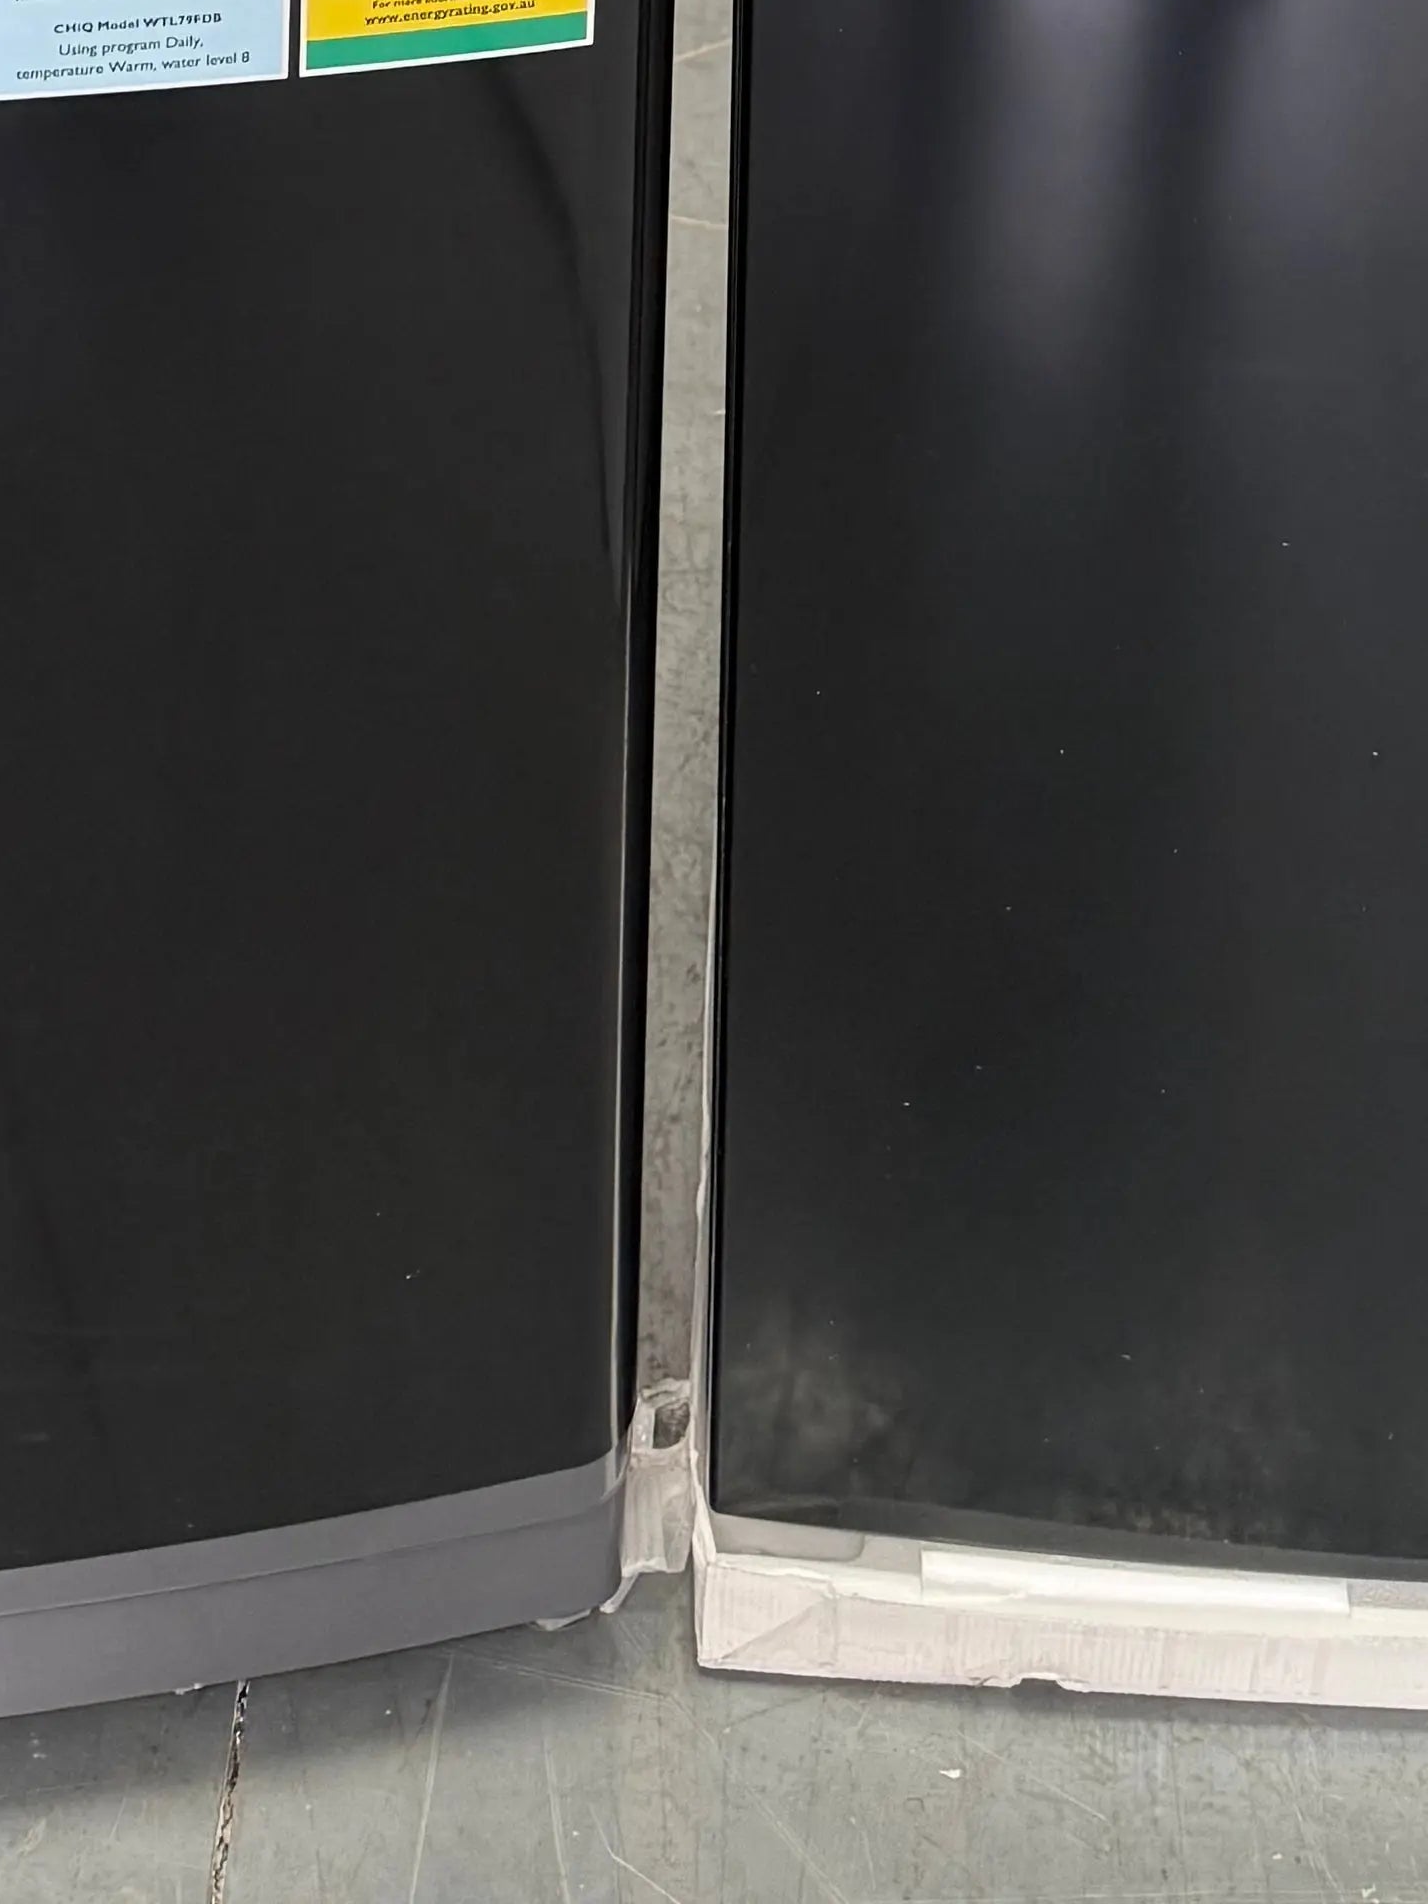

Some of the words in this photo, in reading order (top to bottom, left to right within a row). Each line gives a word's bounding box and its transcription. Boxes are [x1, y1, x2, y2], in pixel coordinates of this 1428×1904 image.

[372, 0, 391, 10] For
[97, 18, 140, 32] Model
[58, 43, 97, 57] Using
[101, 40, 161, 56] program
[16, 64, 104, 82] temperature
[109, 59, 158, 74] Warm,
[161, 56, 201, 69] water
[205, 53, 238, 66] level
[241, 51, 250, 64] 8
